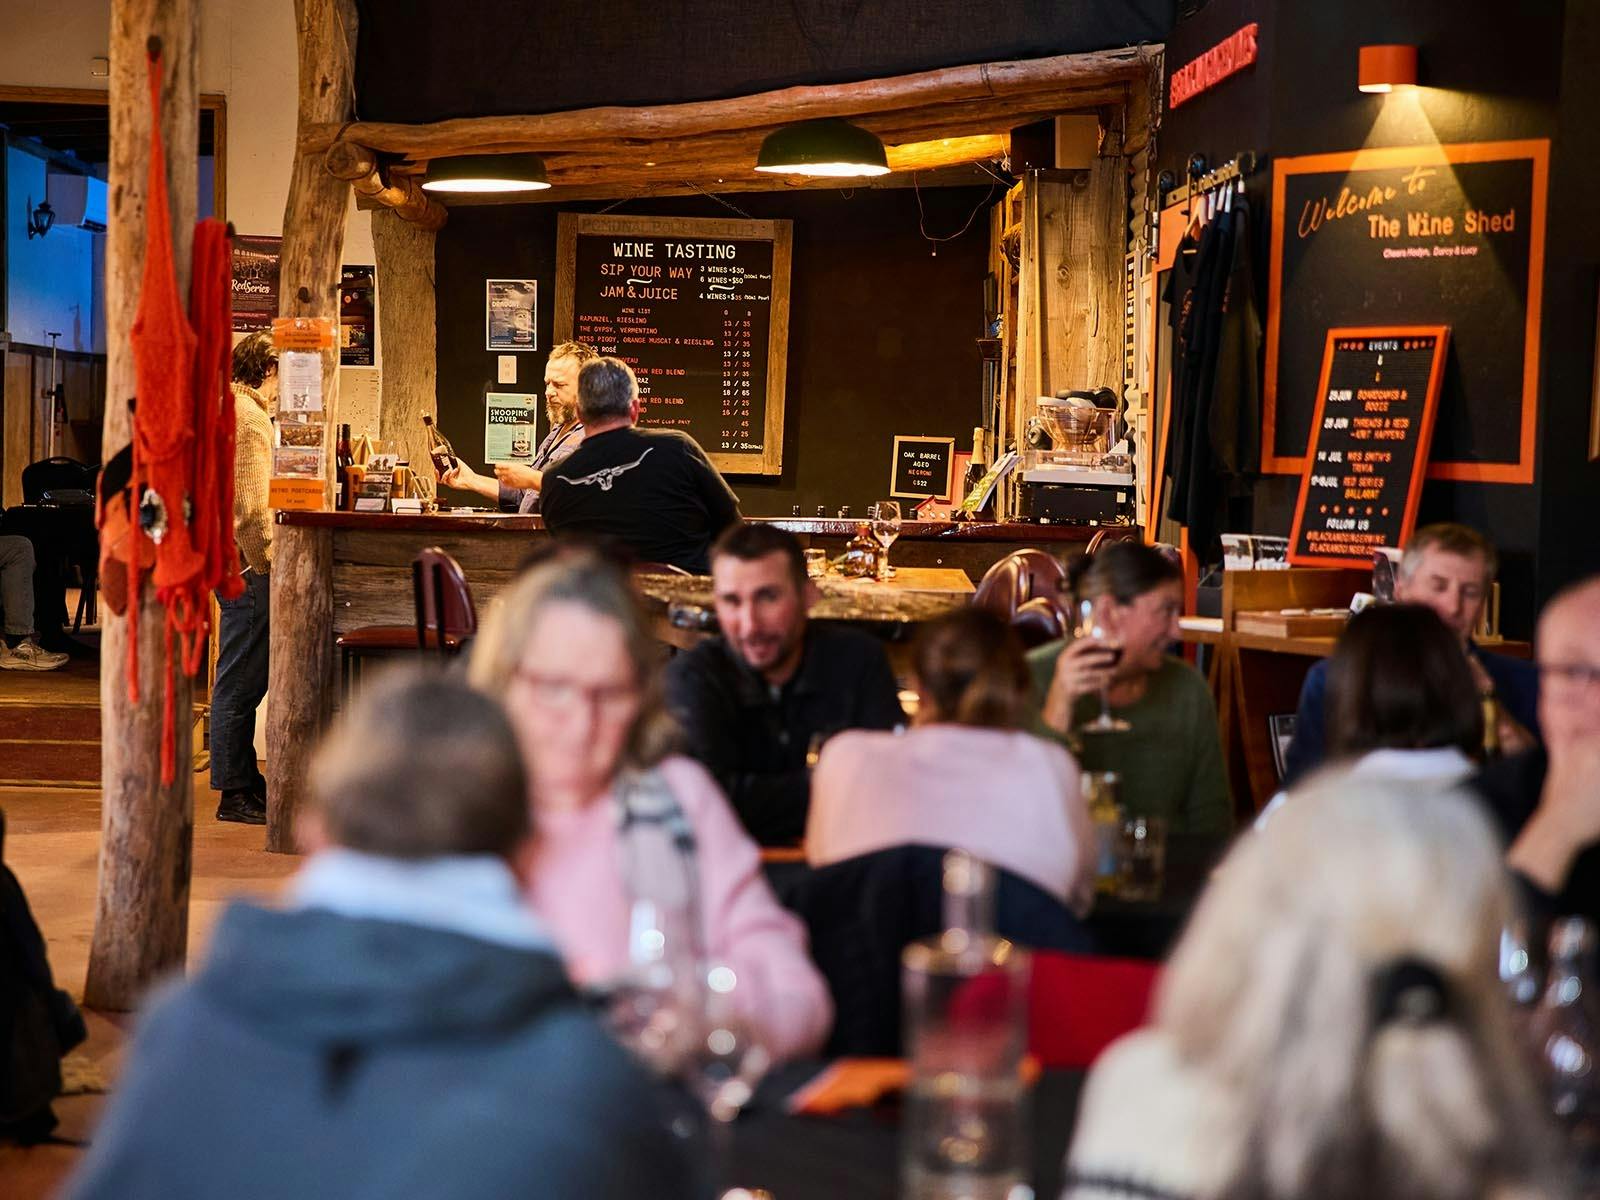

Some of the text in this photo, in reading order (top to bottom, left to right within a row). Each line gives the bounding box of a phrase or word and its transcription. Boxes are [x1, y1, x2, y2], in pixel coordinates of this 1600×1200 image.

[1297, 165, 1437, 238] Welcome to
[1368, 208, 1515, 239] The Wine Shed
[613, 242, 736, 259] WINE TASTING
[600, 263, 693, 279] SIP YOUR WAY
[599, 285, 679, 301] JAM & JUICE
[601, 345, 616, 353] ROSÉ
[683, 338, 714, 346] RIESLING
[1368, 340, 1399, 351] EVENTS
[490, 409, 528, 417] SWOOPING
[1326, 518, 1370, 531] FOLLOW US
